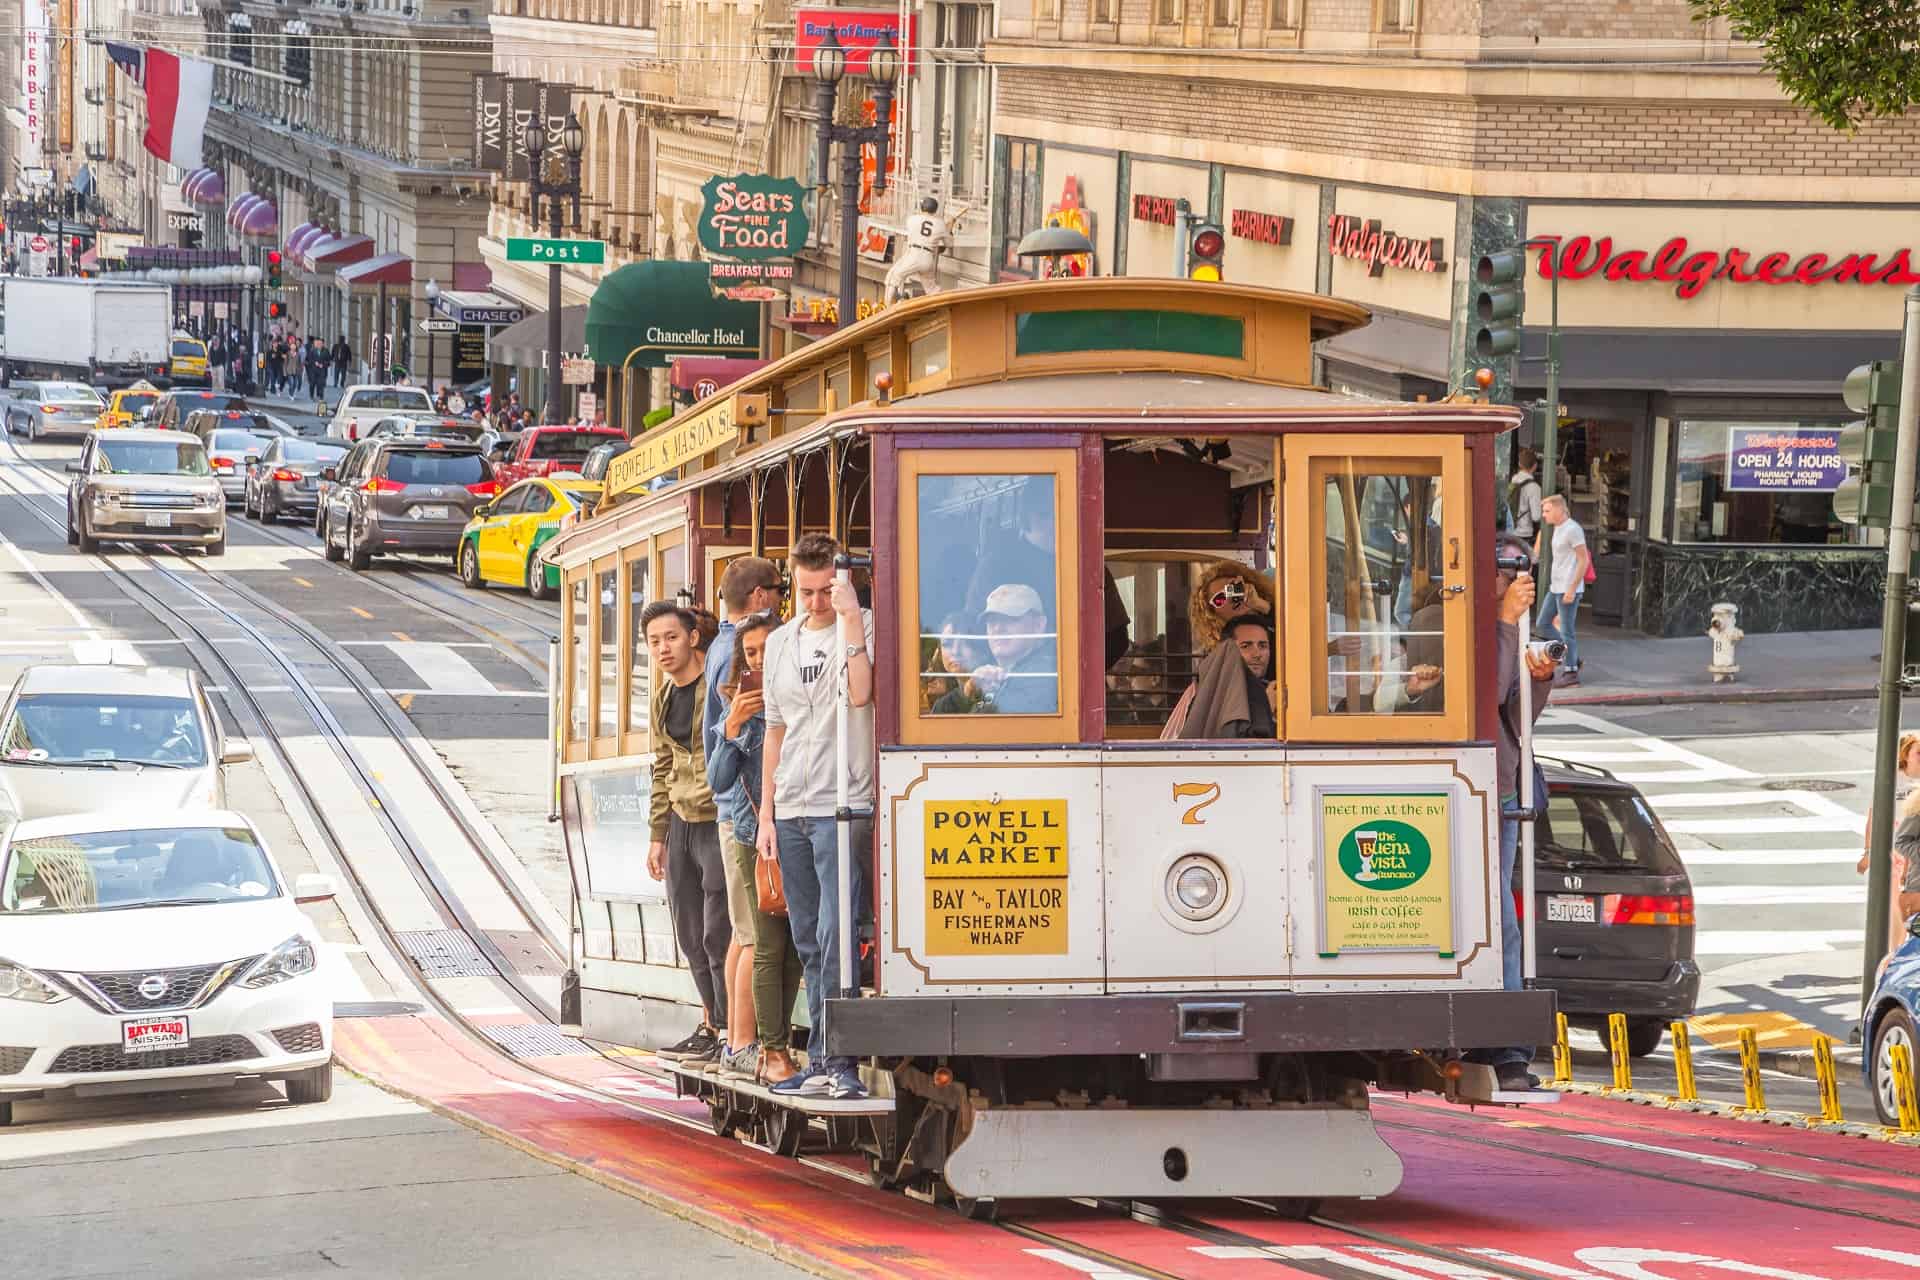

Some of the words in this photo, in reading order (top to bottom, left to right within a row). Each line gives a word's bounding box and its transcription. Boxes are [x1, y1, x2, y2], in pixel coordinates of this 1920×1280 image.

[841, 25, 852, 37] of
[28, 31, 37, 144] HERBERT
[484, 102, 501, 151] DSW
[714, 182, 794, 212] Sears
[744, 215, 770, 226] FINE
[1152, 198, 1176, 226] PHOT
[711, 214, 788, 249] Food
[920, 220, 933, 237] 6
[1232, 209, 1284, 246] PHARMACY
[532, 243, 580, 259] Post
[1328, 213, 1437, 277] Walgreens
[713, 264, 762, 278] BREAKFAST
[765, 266, 793, 279] LUNCH
[1526, 235, 1920, 299] Walgreens
[463, 310, 508, 321] CHASE
[646, 327, 711, 344] Chancellor
[714, 328, 744, 345] Hotel
[698, 382, 715, 400] 78
[614, 447, 656, 487] POWELL
[674, 415, 715, 458] MASON
[1738, 454, 1771, 468] OPEN
[1776, 451, 1793, 468] 24
[1798, 454, 1842, 469] HOURS
[1754, 471, 1793, 480] PHARMACY
[1797, 471, 1823, 480] HOURS
[1172, 782, 1221, 825] 7
[1401, 804, 1423, 815] the
[934, 811, 1059, 829] POWELL
[968, 831, 1028, 845] AND
[931, 846, 1061, 864] MARKET
[933, 889, 964, 910] BAY
[971, 890, 991, 910] AND
[996, 888, 1062, 909] TAYLOR
[1348, 905, 1378, 916] Irish
[1381, 905, 1424, 918] coffee
[945, 915, 1051, 929] FISHERMANS
[970, 931, 1025, 945] WHARF
[134, 1034, 177, 1045] NISSAN
